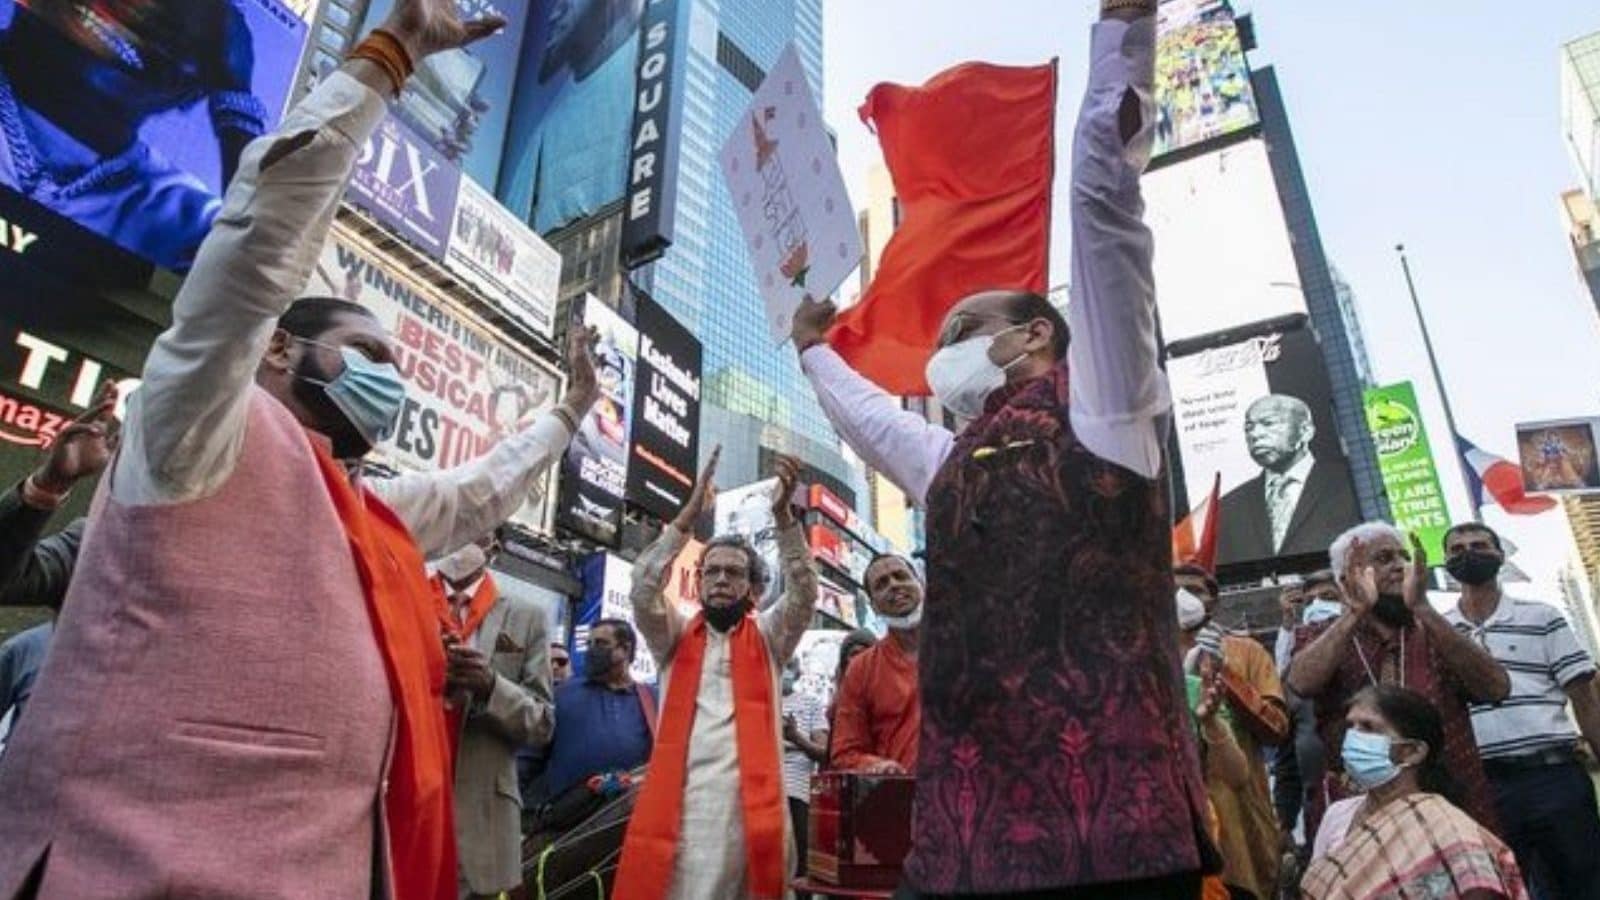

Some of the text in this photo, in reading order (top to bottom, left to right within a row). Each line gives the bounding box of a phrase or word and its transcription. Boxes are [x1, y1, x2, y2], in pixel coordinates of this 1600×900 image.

[631, 20, 668, 221] SQUARE
[395, 344, 502, 430] USICAL
[400, 314, 483, 384] BEST
